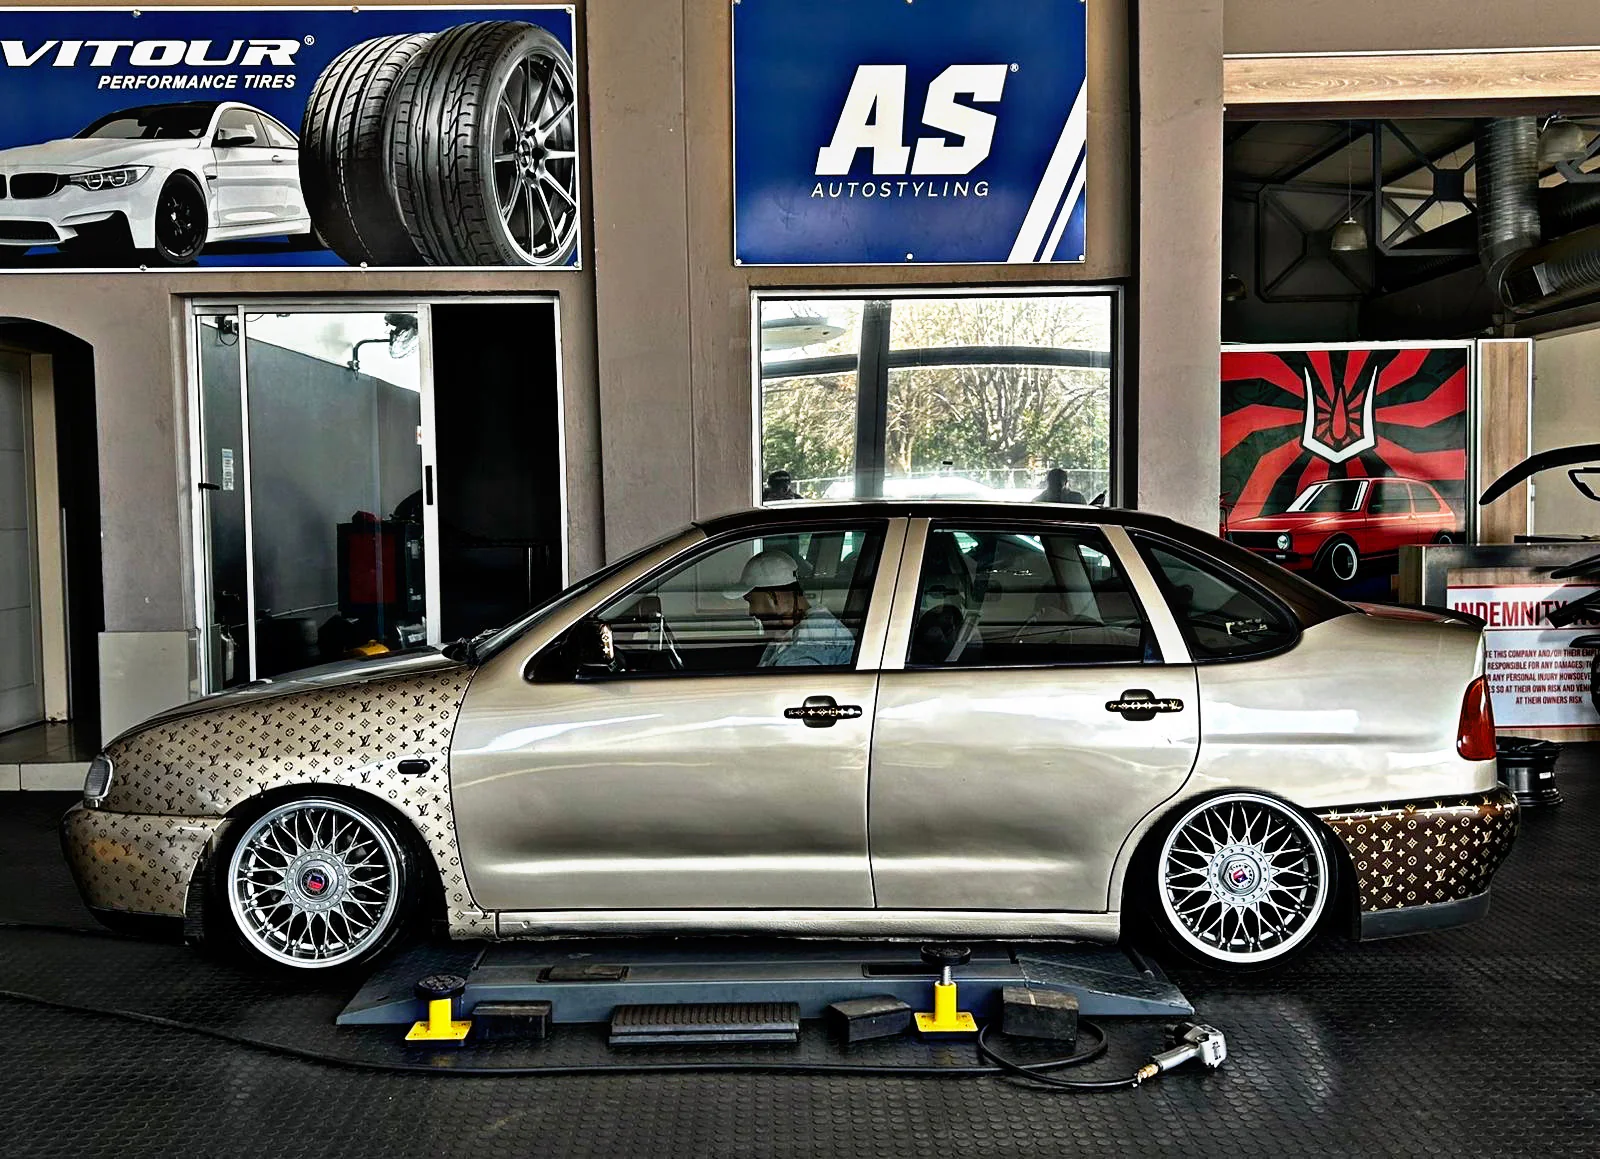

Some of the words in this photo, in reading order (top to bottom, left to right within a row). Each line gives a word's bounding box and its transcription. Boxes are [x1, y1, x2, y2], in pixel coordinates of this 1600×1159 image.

[1, 39, 301, 67] VITOUR
[97, 74, 238, 90] PERFORMANCE
[243, 74, 297, 90] TIRES
[814, 64, 1008, 176] AS
[810, 181, 990, 198] AUTOSTYLING
[1494, 650, 1507, 659] THIS
[1508, 650, 1537, 658] COMPANY
[1563, 649, 1581, 657] THEIR
[1487, 662, 1527, 670] RESPONSIBLE
[1528, 661, 1540, 670] FOR
[1541, 661, 1553, 669] ANY
[1492, 673, 1504, 682] ANY
[1506, 673, 1536, 681] PERSONAL
[1537, 672, 1557, 681] INJURY
[1559, 672, 1592, 680] HOWSOEVE
[1496, 685, 1504, 693] SO
[1505, 685, 1512, 693] AT
[1514, 685, 1531, 693] THEIR
[1532, 684, 1546, 693] OWN
[1547, 684, 1561, 692] RISK
[1562, 684, 1575, 692] AND
[1516, 696, 1523, 704] AT
[1524, 696, 1541, 704] THEIR
[1542, 695, 1568, 704] OWNERS
[1569, 695, 1582, 704] RISK
